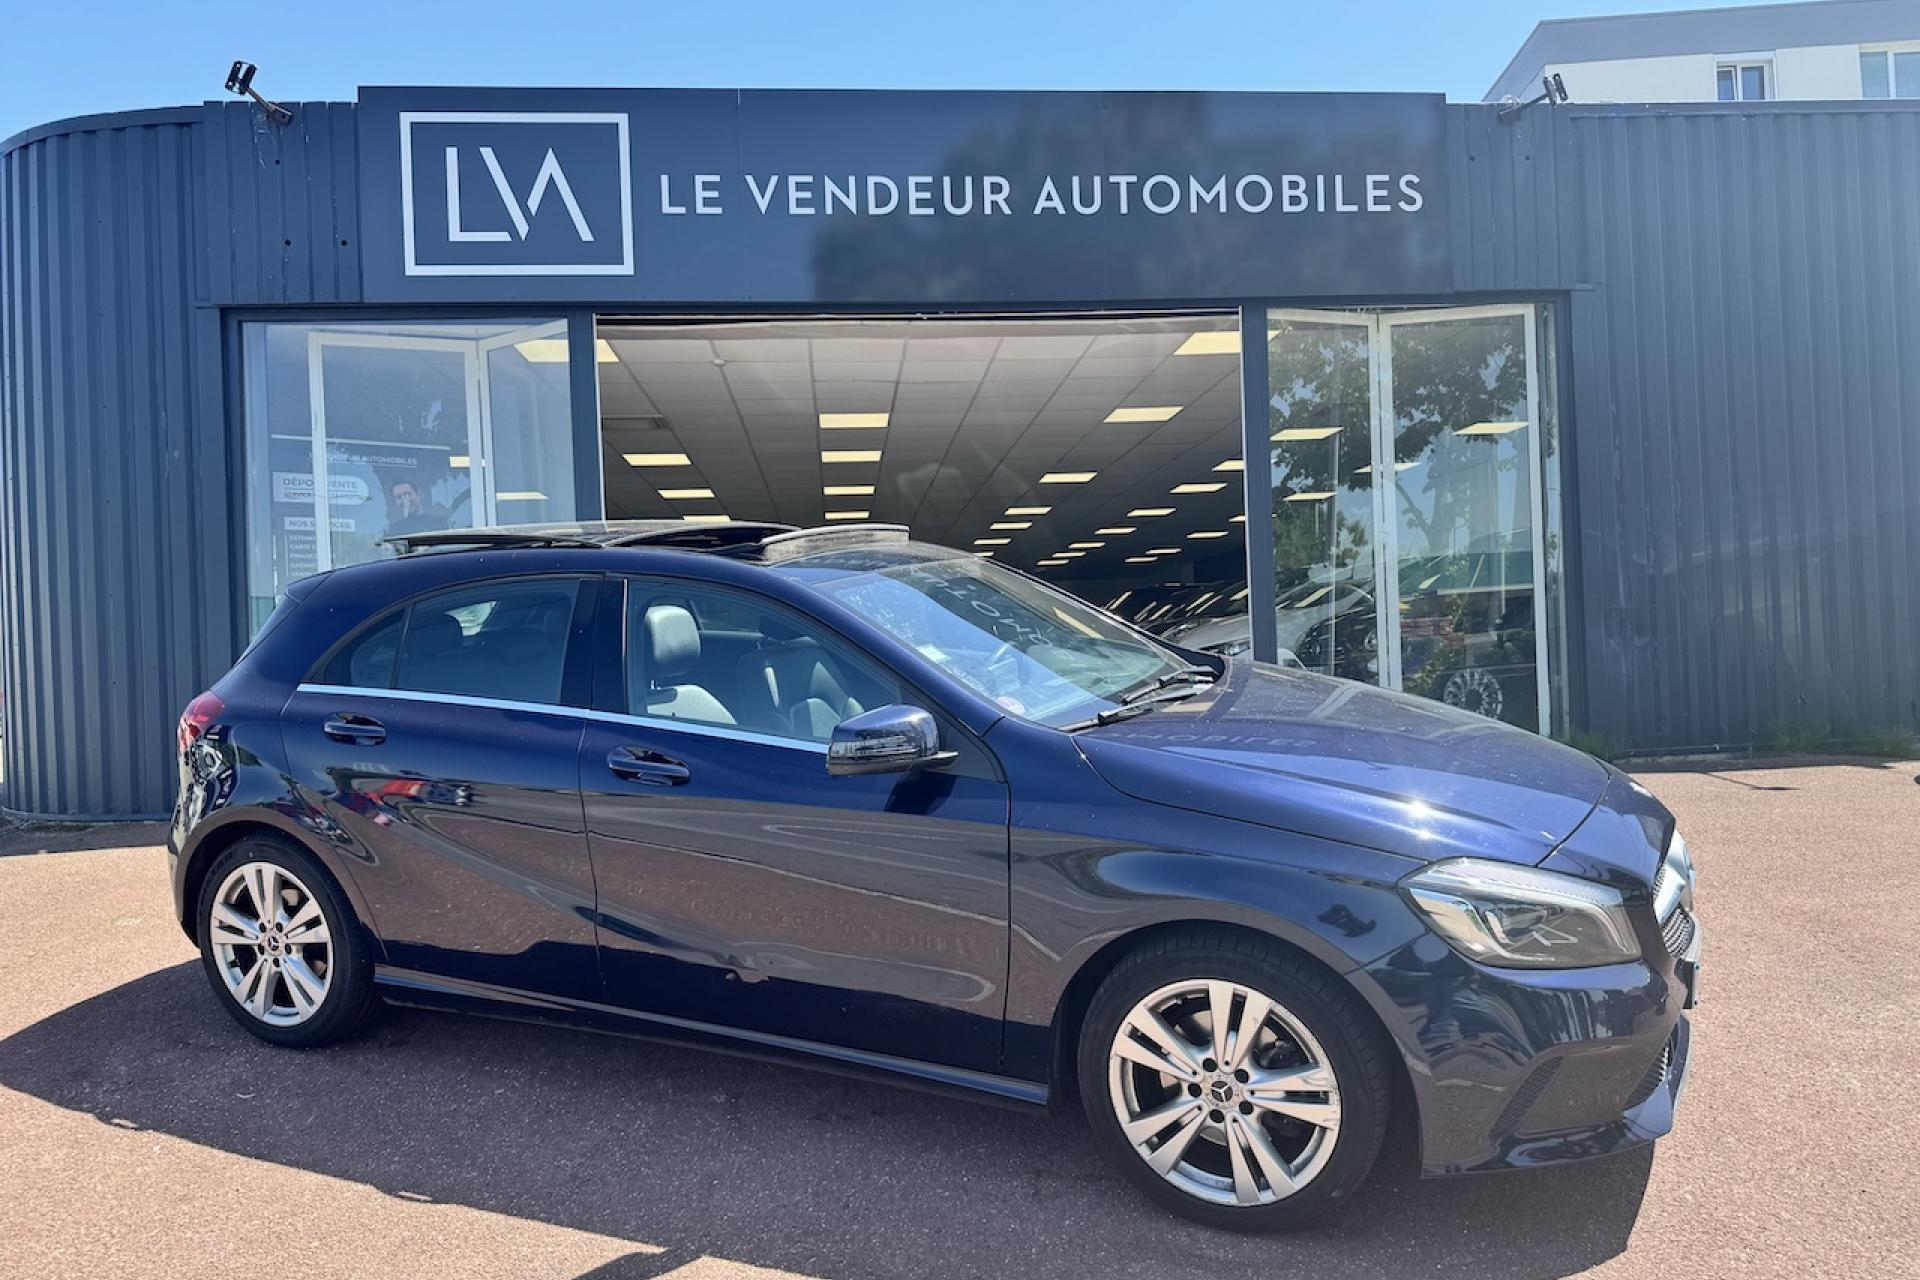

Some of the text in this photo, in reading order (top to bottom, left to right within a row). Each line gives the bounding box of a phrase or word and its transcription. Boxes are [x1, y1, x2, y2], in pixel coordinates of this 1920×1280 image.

[445, 146, 594, 242] LVA
[660, 172, 1424, 216] LE VENDEUR AUTOMOBILES
[282, 476, 314, 487] DÉPO
[289, 519, 308, 528] NOS
